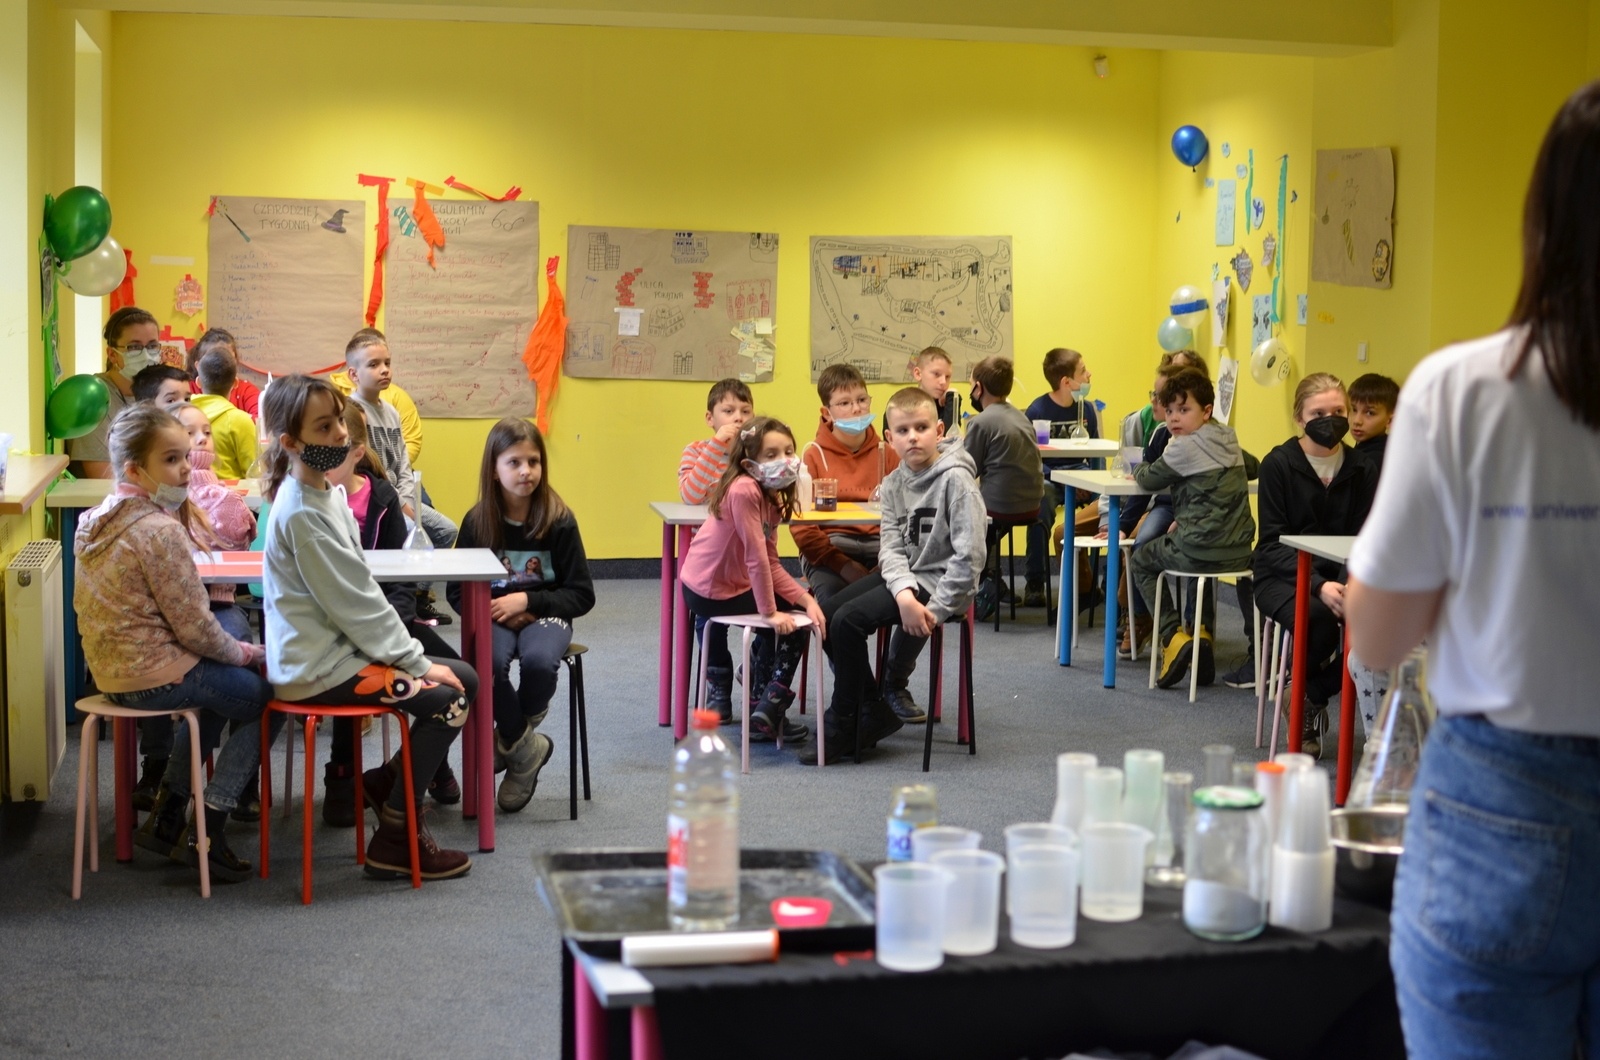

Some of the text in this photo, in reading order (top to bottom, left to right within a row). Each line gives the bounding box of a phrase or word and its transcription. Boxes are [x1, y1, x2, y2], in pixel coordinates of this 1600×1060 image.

[253, 203, 320, 222] CZARODZIEJ
[432, 204, 487, 216] EGULAMIN
[259, 219, 310, 232] TYGODNIA
[439, 217, 468, 227] ZKOŁY
[442, 226, 461, 235] AGII
